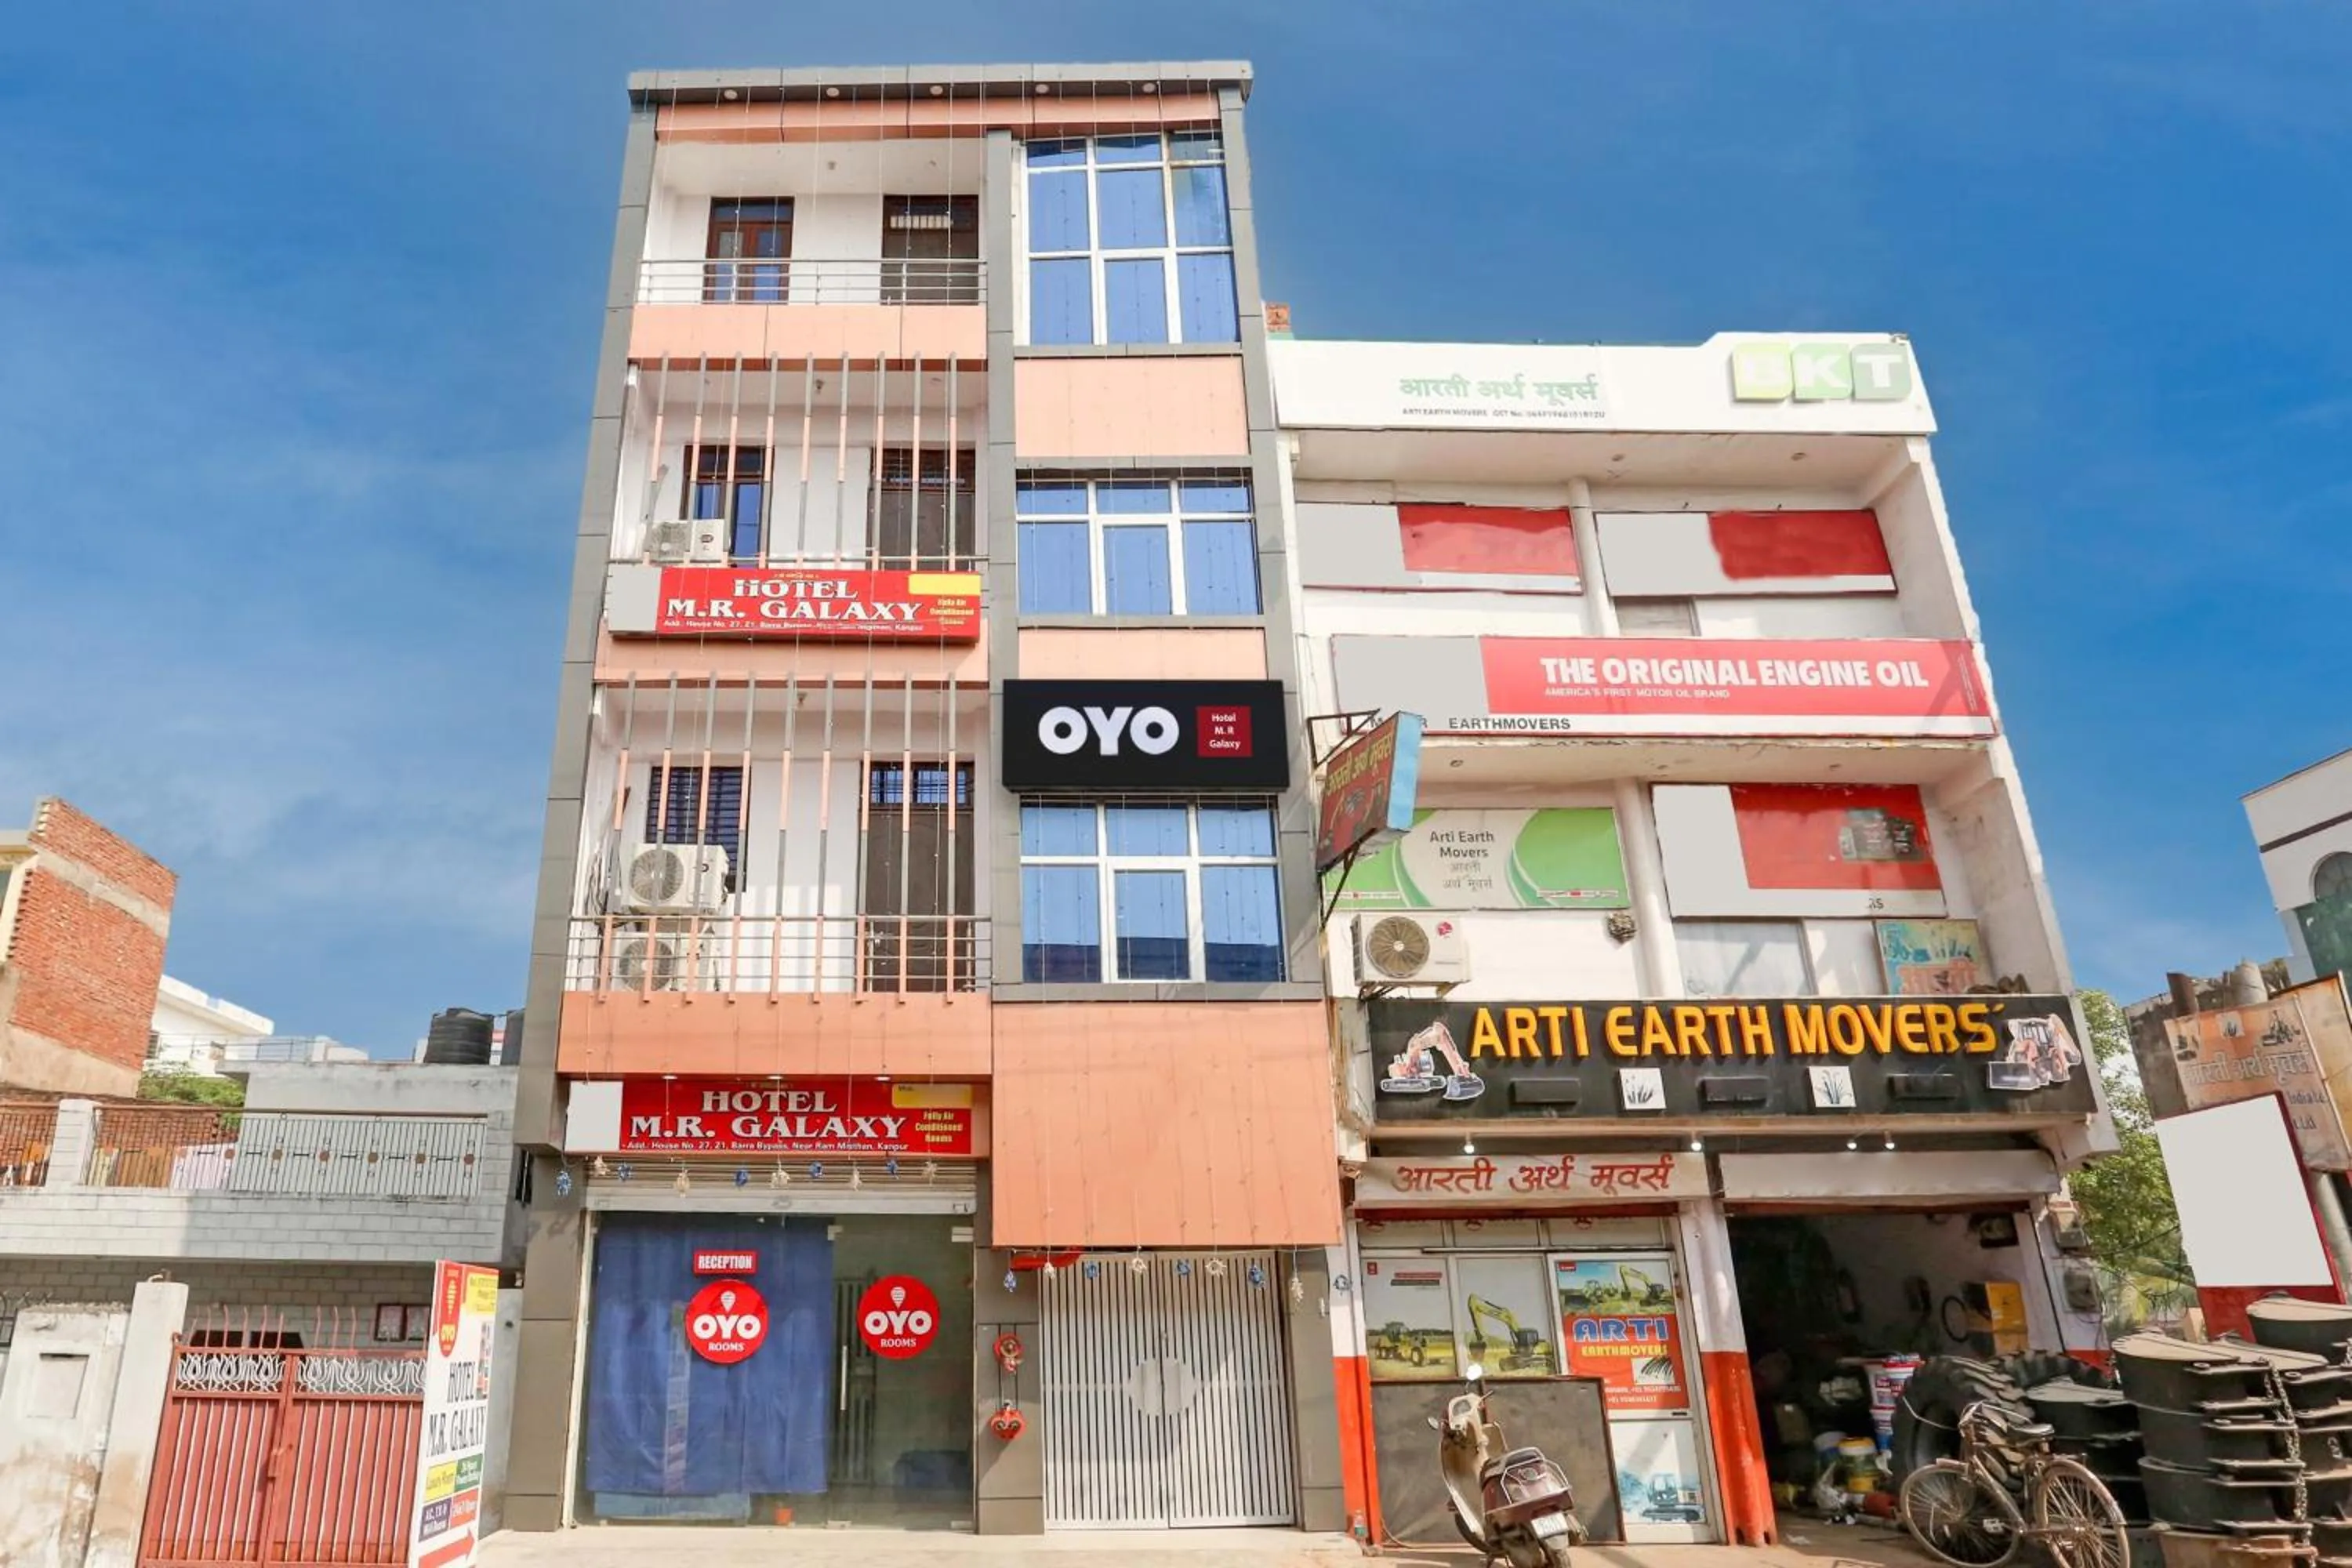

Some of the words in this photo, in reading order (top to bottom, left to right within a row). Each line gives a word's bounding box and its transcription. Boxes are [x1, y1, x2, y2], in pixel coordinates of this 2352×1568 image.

[1400, 374, 1471, 397] आरती
[1478, 373, 1526, 400] अर्थ
[1533, 373, 1599, 406] मूवर्स
[732, 578, 858, 598] HOTEL
[666, 599, 746, 618] M.R.
[760, 601, 924, 621] GALAXY
[1540, 657, 1597, 684] THE
[1602, 657, 1756, 687] ORIGINAL
[1759, 659, 1871, 688] ENGINE
[1875, 661, 1929, 688] OIL
[1544, 687, 1601, 697] AMERICA'S
[1604, 688, 1632, 697] FIRST
[1637, 688, 1672, 697] MOTOR
[1675, 688, 1690, 698] OIL
[1693, 688, 1730, 699] BRAND
[1211, 713, 1236, 723] Hotel
[1449, 717, 1571, 730] EARTHMOVERS
[1037, 706, 1180, 756] OYO
[1209, 739, 1241, 750] Galaxy
[1429, 830, 1454, 843] Arti
[1458, 830, 1494, 843] Earth
[1439, 846, 1489, 858] Movers
[1469, 1006, 1590, 1058] ARTI
[1605, 1005, 1775, 1057] EARTH
[1784, 1004, 2005, 1055] MOVERS
[701, 1091, 837, 1112] HOTEL
[630, 1116, 716, 1138] M.R.
[731, 1116, 906, 1138] GALAXY
[877, 1142, 909, 1152] Kanpur
[1390, 1157, 1496, 1194] आरती
[1509, 1156, 1575, 1193] अर्थ
[1590, 1153, 1675, 1196] मूवर्स
[698, 1254, 753, 1269] RECEPTION
[692, 1314, 761, 1340] OYO
[864, 1310, 932, 1335] OYO
[1572, 1317, 1669, 1343] ARTI
[707, 1341, 746, 1352] ROOMS
[880, 1338, 916, 1348] ROOMS
[1581, 1344, 1668, 1357] EARTHMOVERS
[447, 1361, 475, 1403] HOTEL
